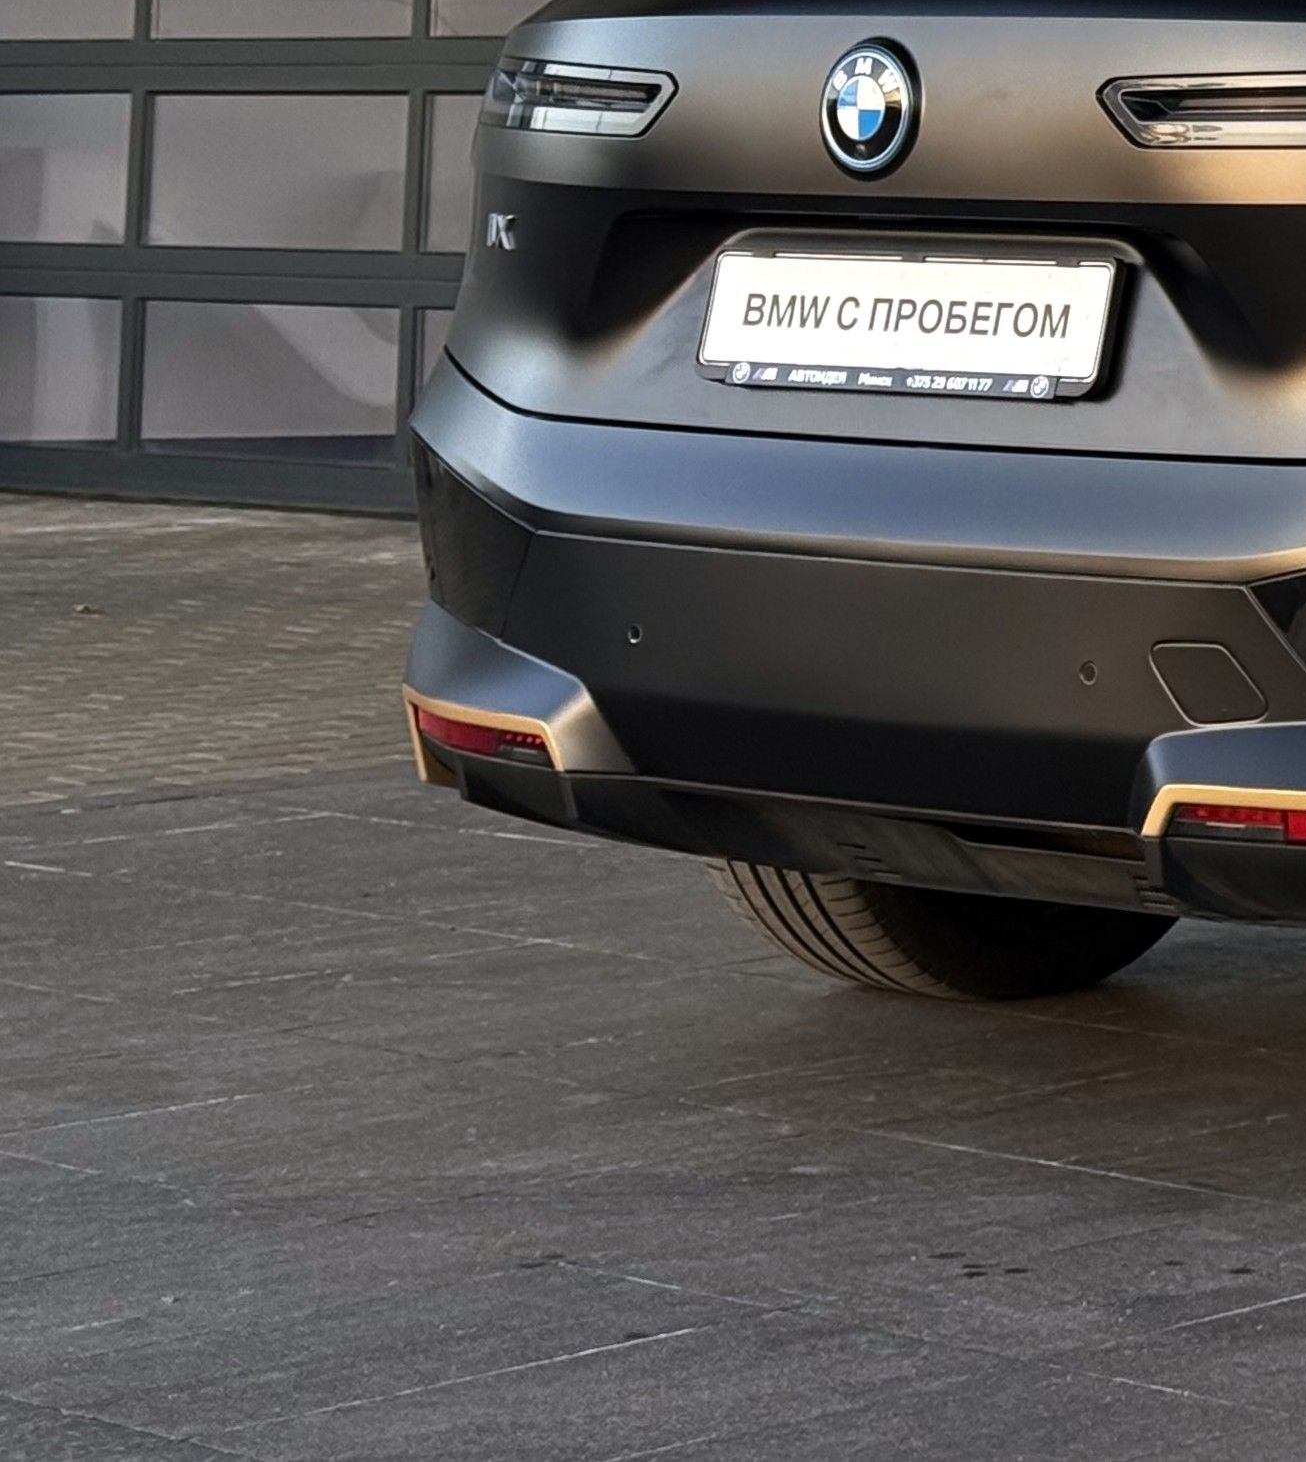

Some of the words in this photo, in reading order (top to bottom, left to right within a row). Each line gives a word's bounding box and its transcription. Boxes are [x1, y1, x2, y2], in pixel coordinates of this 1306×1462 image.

[832, 57, 901, 94] BMW
[742, 292, 830, 329] BMW
[837, 296, 861, 330] С
[867, 297, 1072, 339] ПРОБЕГОМ
